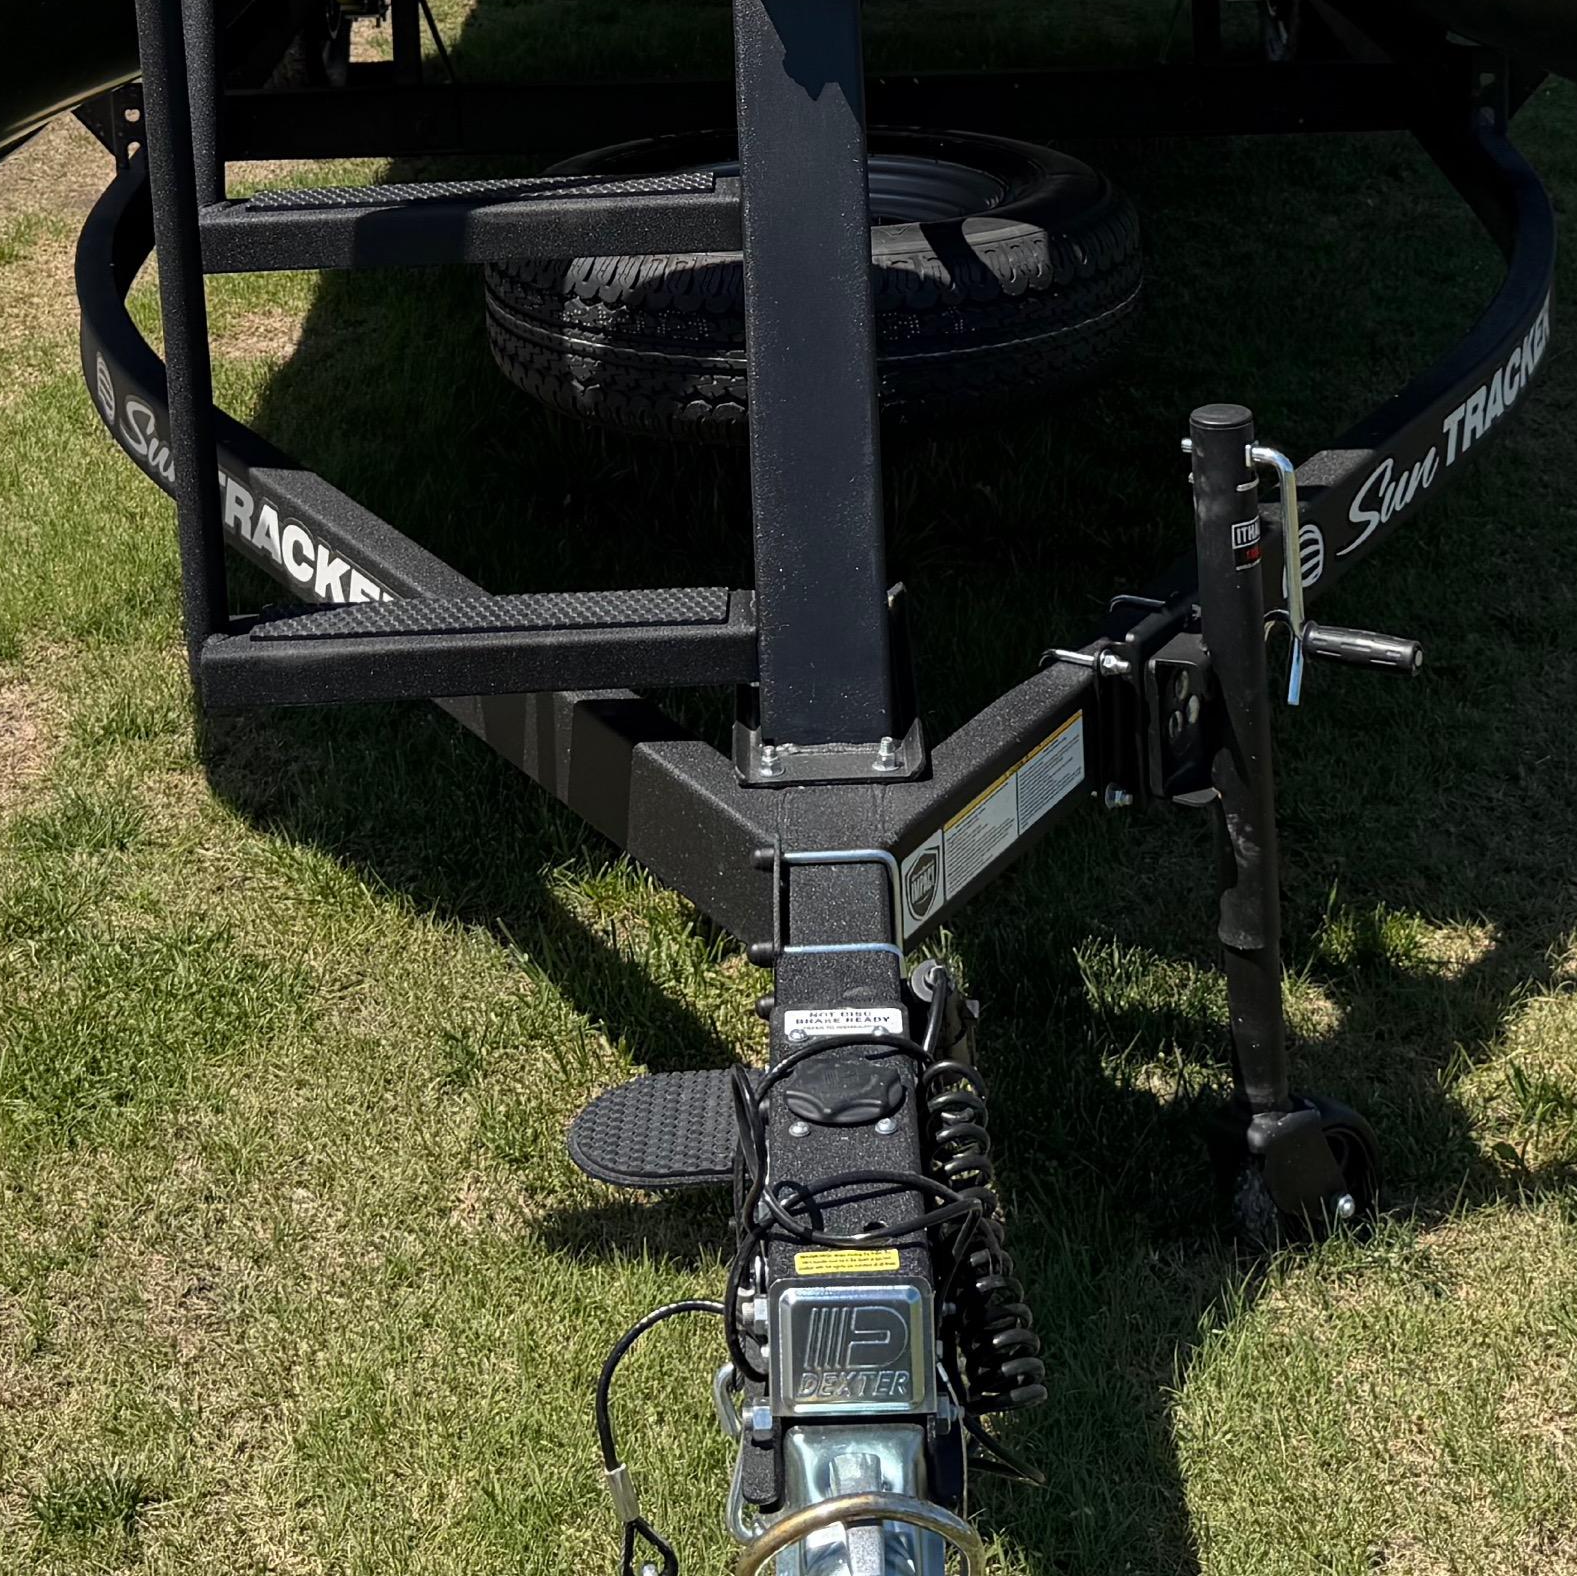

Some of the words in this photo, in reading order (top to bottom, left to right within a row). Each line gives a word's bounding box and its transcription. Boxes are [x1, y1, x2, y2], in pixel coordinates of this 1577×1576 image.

[1337, 446, 1440, 556] Sun
[845, 1016, 891, 1024] READY
[796, 1370, 911, 1398] DEXTER
